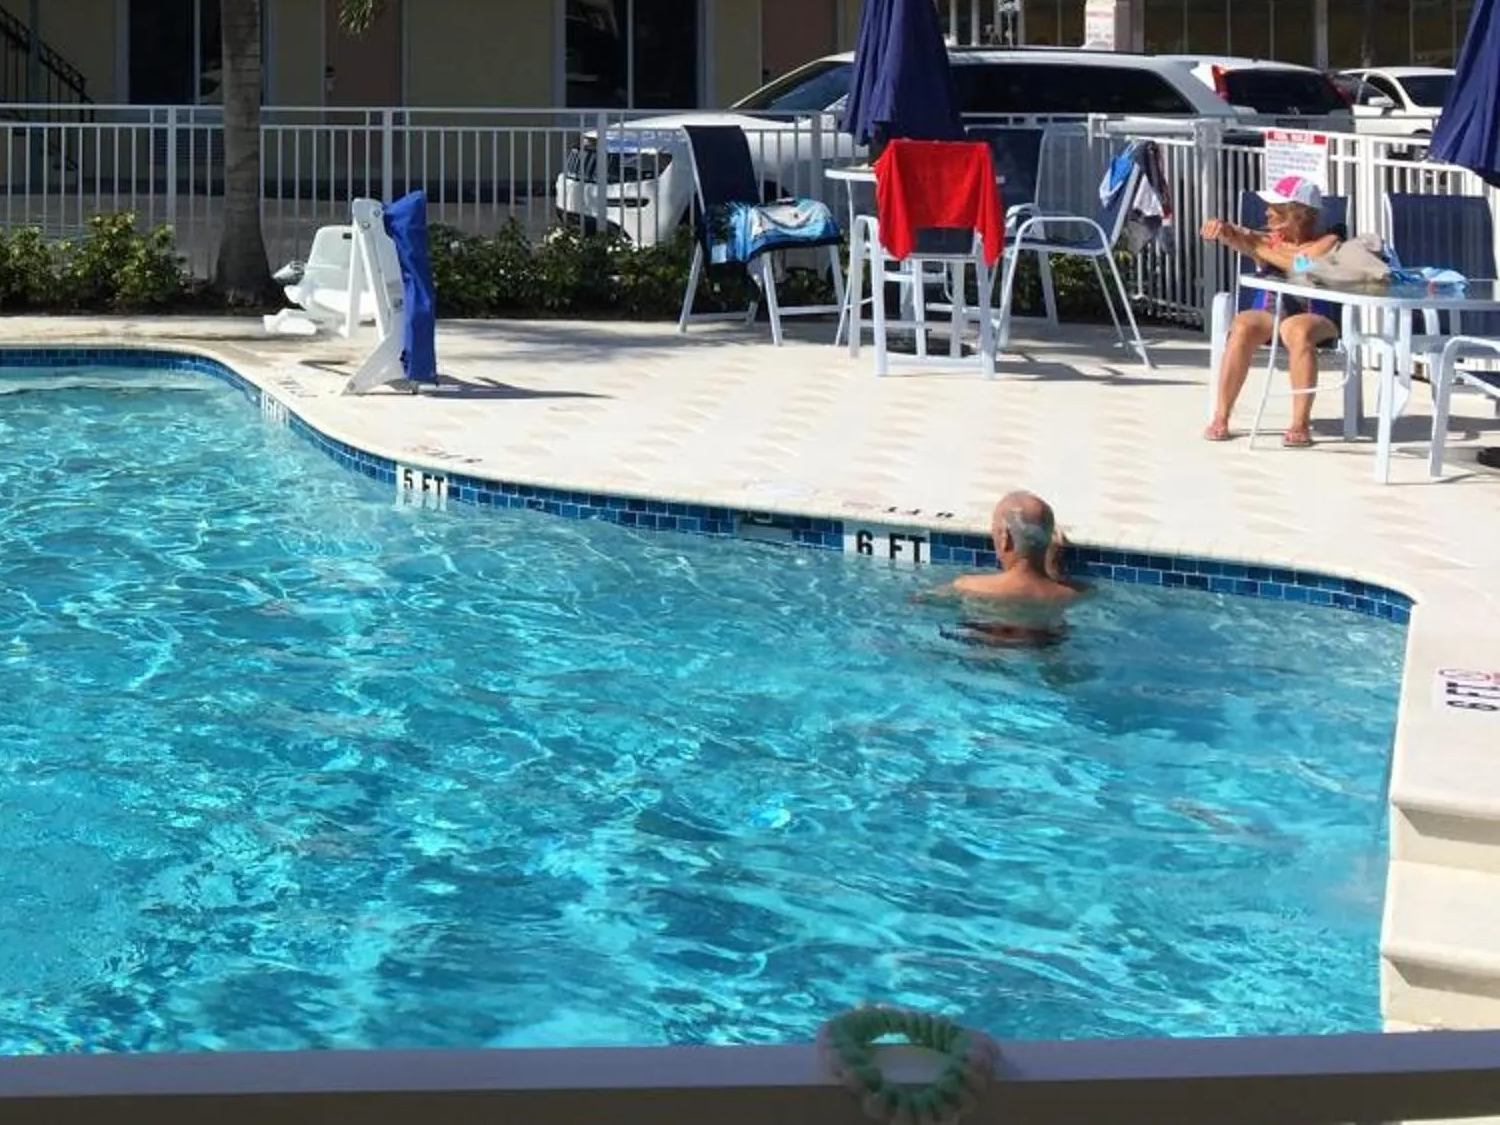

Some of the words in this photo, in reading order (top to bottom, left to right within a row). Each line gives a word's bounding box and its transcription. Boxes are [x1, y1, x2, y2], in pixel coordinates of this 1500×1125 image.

[403, 468, 414, 493] 5
[422, 472, 445, 496] FT
[856, 530, 873, 556] 6
[889, 533, 927, 564] FT
